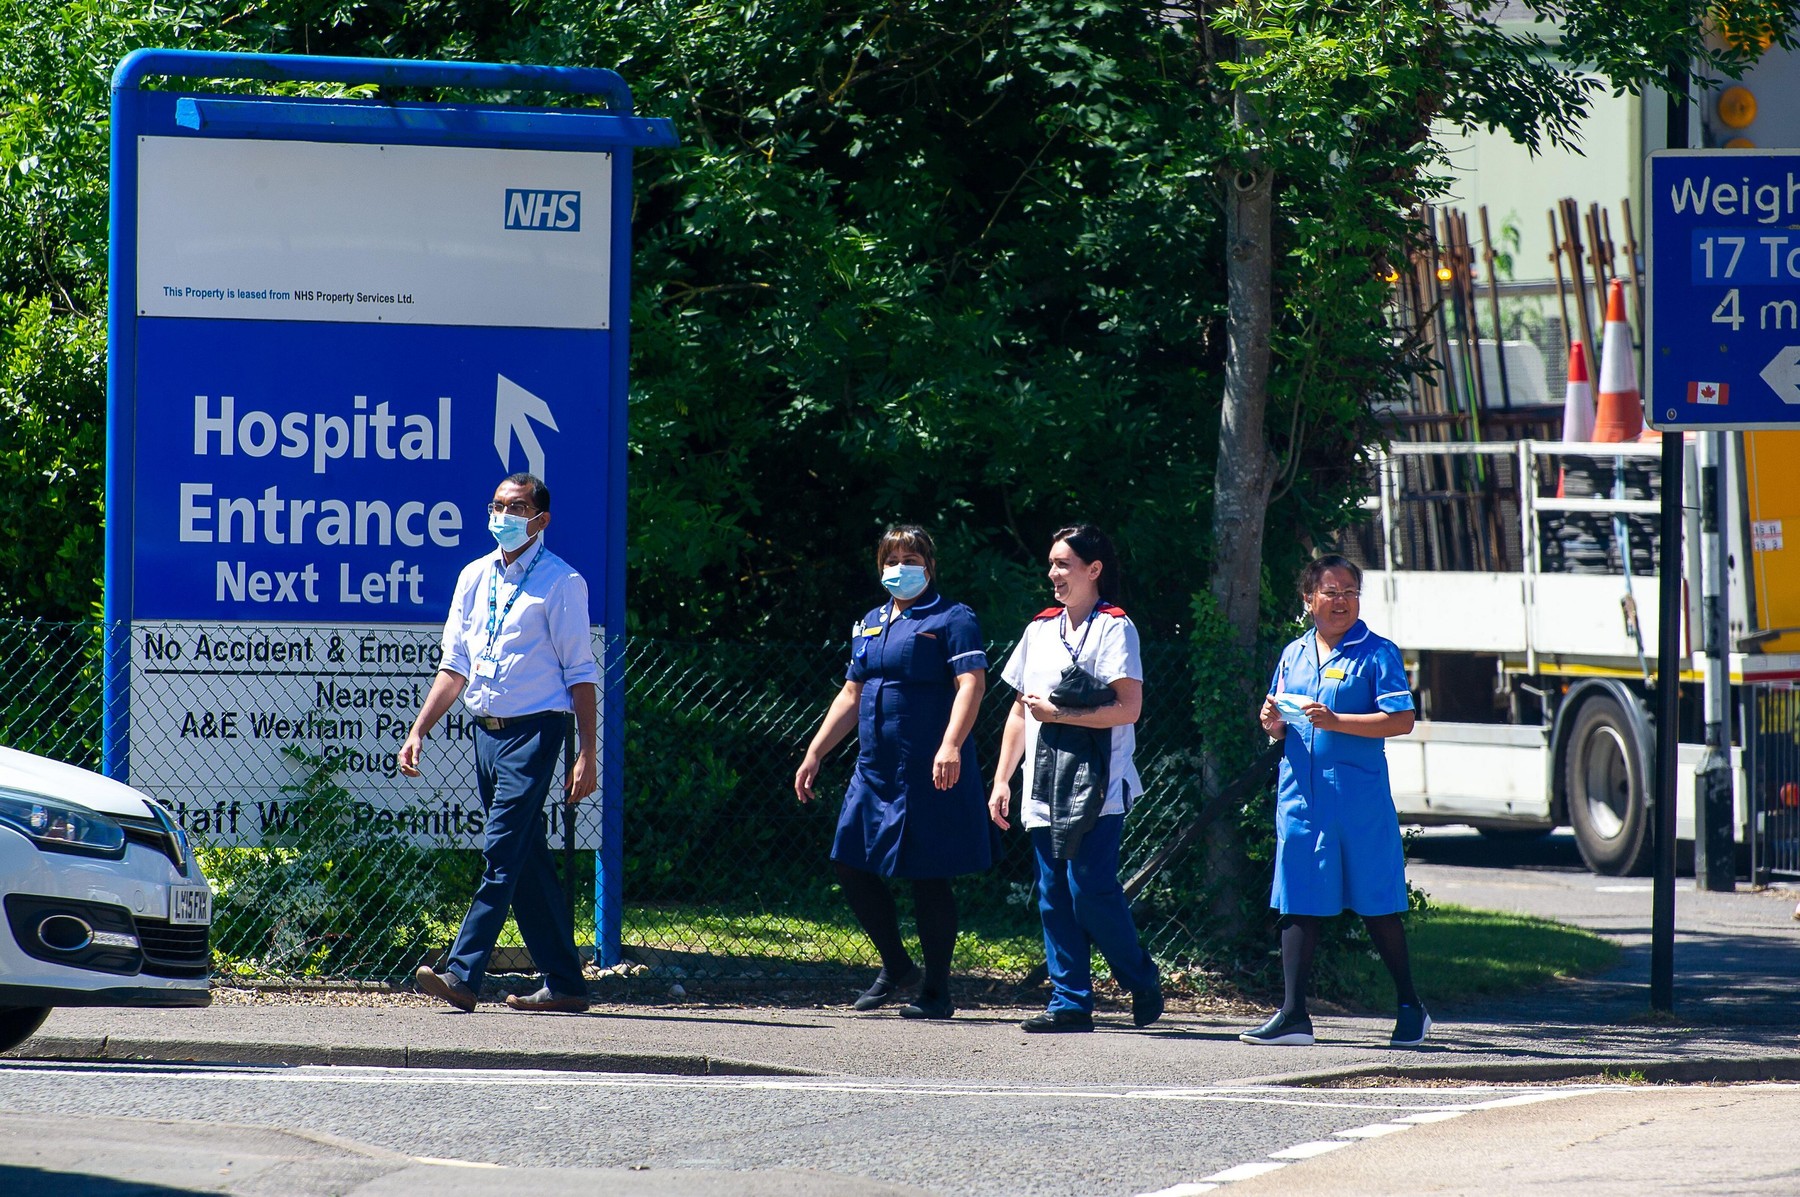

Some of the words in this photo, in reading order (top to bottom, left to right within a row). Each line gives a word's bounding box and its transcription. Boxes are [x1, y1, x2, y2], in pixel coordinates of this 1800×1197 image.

[506, 192, 578, 229] NHS
[1700, 236, 1746, 279] 17
[163, 286, 183, 297] This
[185, 287, 225, 300] Property
[227, 287, 235, 299] is
[237, 288, 267, 300] leased
[269, 289, 290, 300] from
[294, 290, 314, 301] NHS
[316, 291, 354, 304] Property
[356, 291, 395, 304] Services
[397, 292, 415, 304] Ltd.
[1711, 288, 1745, 331] 4
[194, 395, 452, 474] Hospital
[179, 482, 463, 547] Entrance
[216, 561, 319, 603] Next
[339, 560, 424, 604] Left
[145, 633, 180, 661] No
[194, 634, 314, 664] Accident
[327, 636, 345, 663] &
[360, 636, 443, 670] Emerg
[316, 681, 421, 709] Nearest
[180, 711, 238, 739] A&E
[250, 712, 363, 740] Wexham
